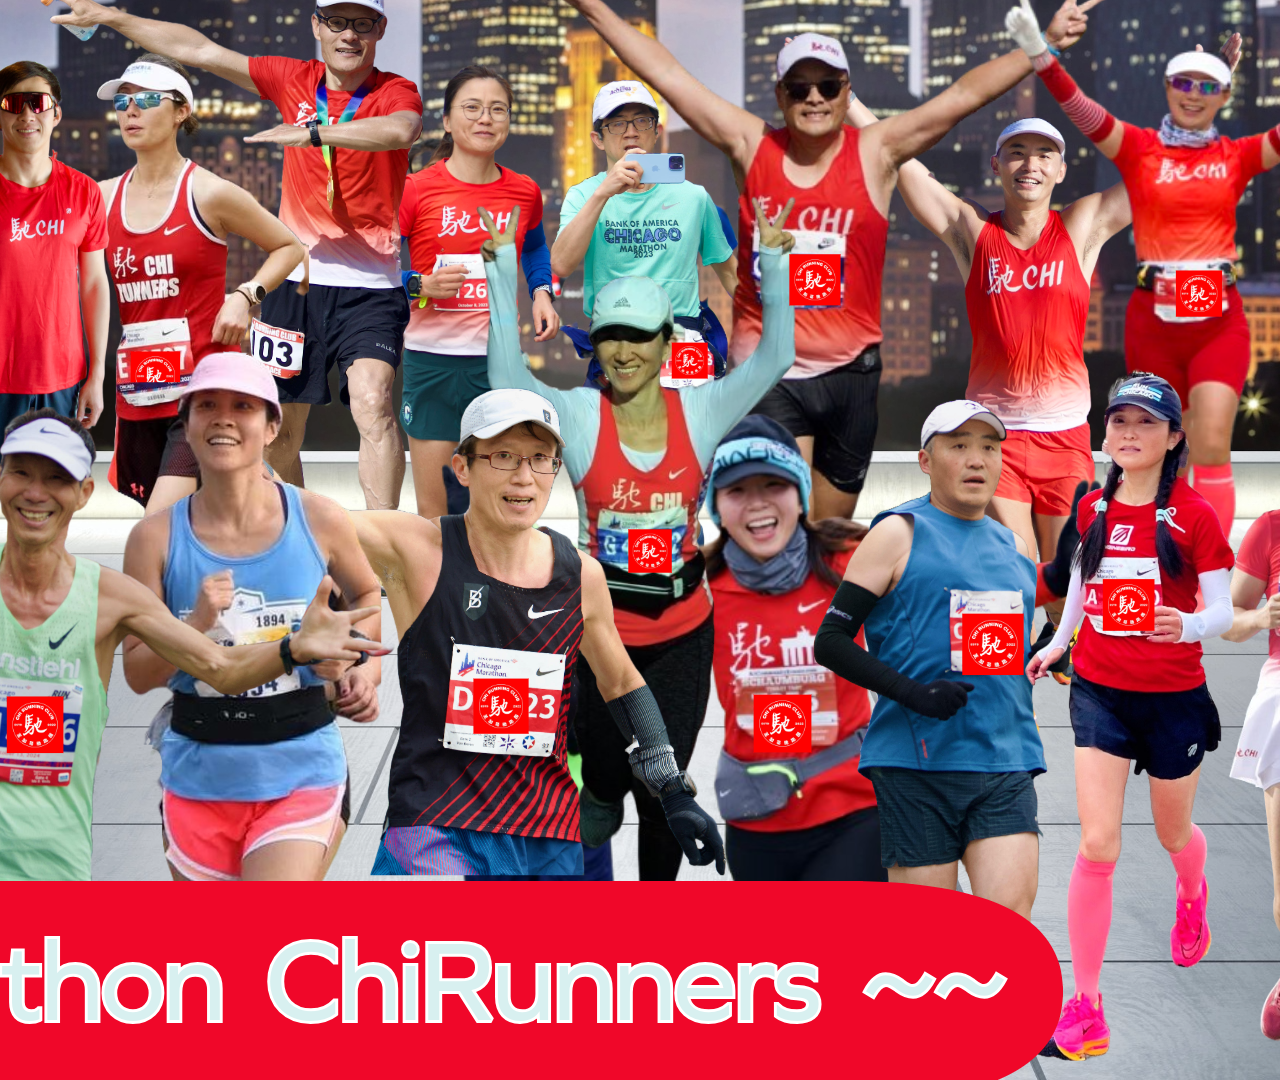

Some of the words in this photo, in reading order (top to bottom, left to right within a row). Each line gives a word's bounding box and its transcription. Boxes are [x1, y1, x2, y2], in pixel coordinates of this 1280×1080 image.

[1193, 162, 1227, 179] CHI
[36, 219, 65, 236] CHI
[605, 219, 628, 227] BANK
[642, 219, 679, 227] AMERICA
[798, 206, 854, 235] CHI
[604, 227, 682, 244] CHICAGO
[619, 243, 667, 253] MARATHON
[634, 250, 653, 258] 2023
[143, 254, 174, 277] CHI
[1022, 260, 1064, 290] CHI
[117, 277, 180, 303] RUNNERS
[650, 491, 683, 512] CHI
[1086, 589, 1097, 605] A
[256, 614, 285, 628] 1894
[475, 668, 507, 678] Marathon
[476, 661, 502, 670] Chicago
[741, 673, 826, 687] SCHAUMBURG
[452, 686, 473, 711] D
